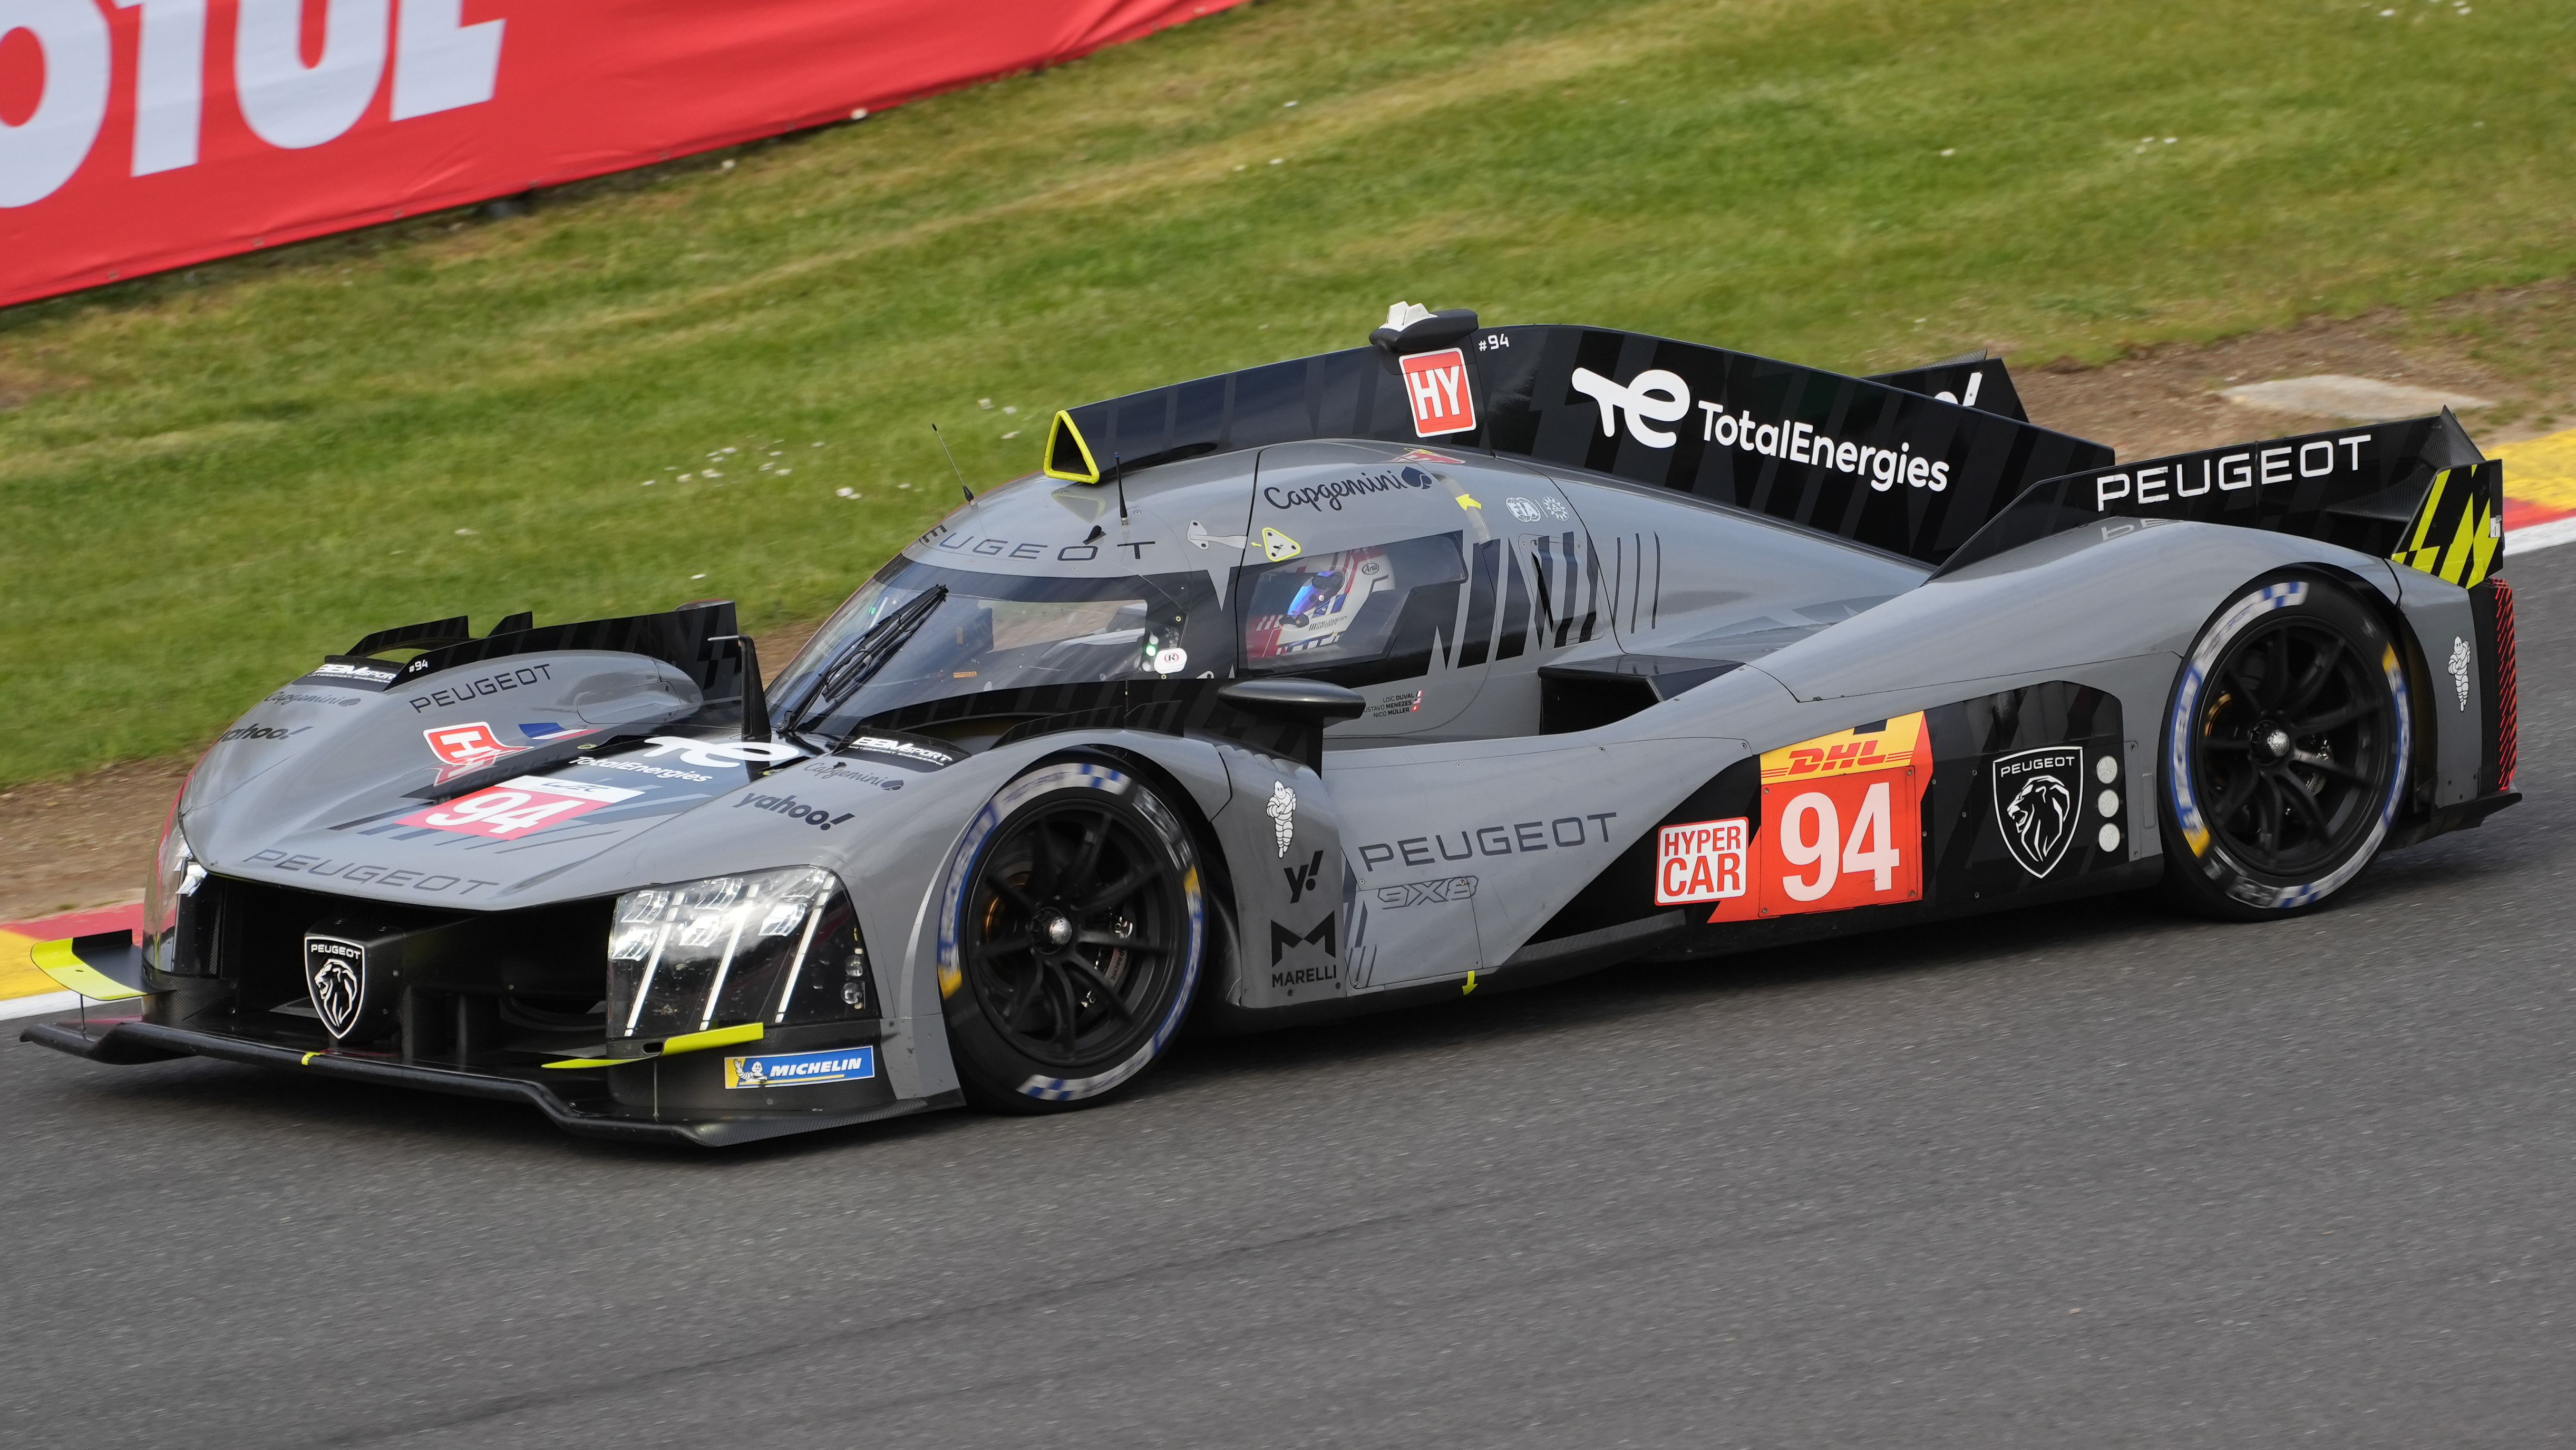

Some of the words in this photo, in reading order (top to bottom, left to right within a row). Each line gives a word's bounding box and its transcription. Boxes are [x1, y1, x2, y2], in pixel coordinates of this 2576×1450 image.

[1479, 333, 1510, 352] #94
[1409, 365, 1461, 421] HY
[1698, 401, 1950, 492] TotalEnergies
[2097, 434, 2371, 512] PEUGEOT
[1264, 470, 1408, 511] Capgemini
[922, 524, 1155, 561] EUGEOT
[1317, 615, 1348, 625] PEUGEOT
[409, 659, 429, 673] #94
[264, 691, 343, 707] Capgemini
[409, 663, 552, 713] PEUGEOT
[1364, 704, 1385, 713] USTAVO
[1386, 700, 1412, 710] MENEZES
[219, 723, 314, 742] ahoo!
[568, 756, 713, 782] TotalEnergies
[848, 745, 896, 755] MOTORSPORT
[897, 752, 945, 766] ENGINEERING
[1788, 739, 1887, 776] DHL
[2000, 756, 2075, 778] PEUGEOT
[803, 762, 885, 787] Capgemini
[425, 791, 586, 834] 94
[732, 792, 856, 830] yahoo!
[1358, 812, 1617, 872] PEUGEOT
[1664, 825, 1741, 857] HYPER
[1780, 782, 1900, 902] 94
[242, 849, 500, 895] PEUGEOT
[1663, 852, 1741, 897] CAR
[1377, 875, 1479, 910] 9X8
[310, 943, 361, 960] PEUGEOT
[1271, 964, 1337, 988] MARELLI
[769, 1057, 862, 1077] MICHELIN
